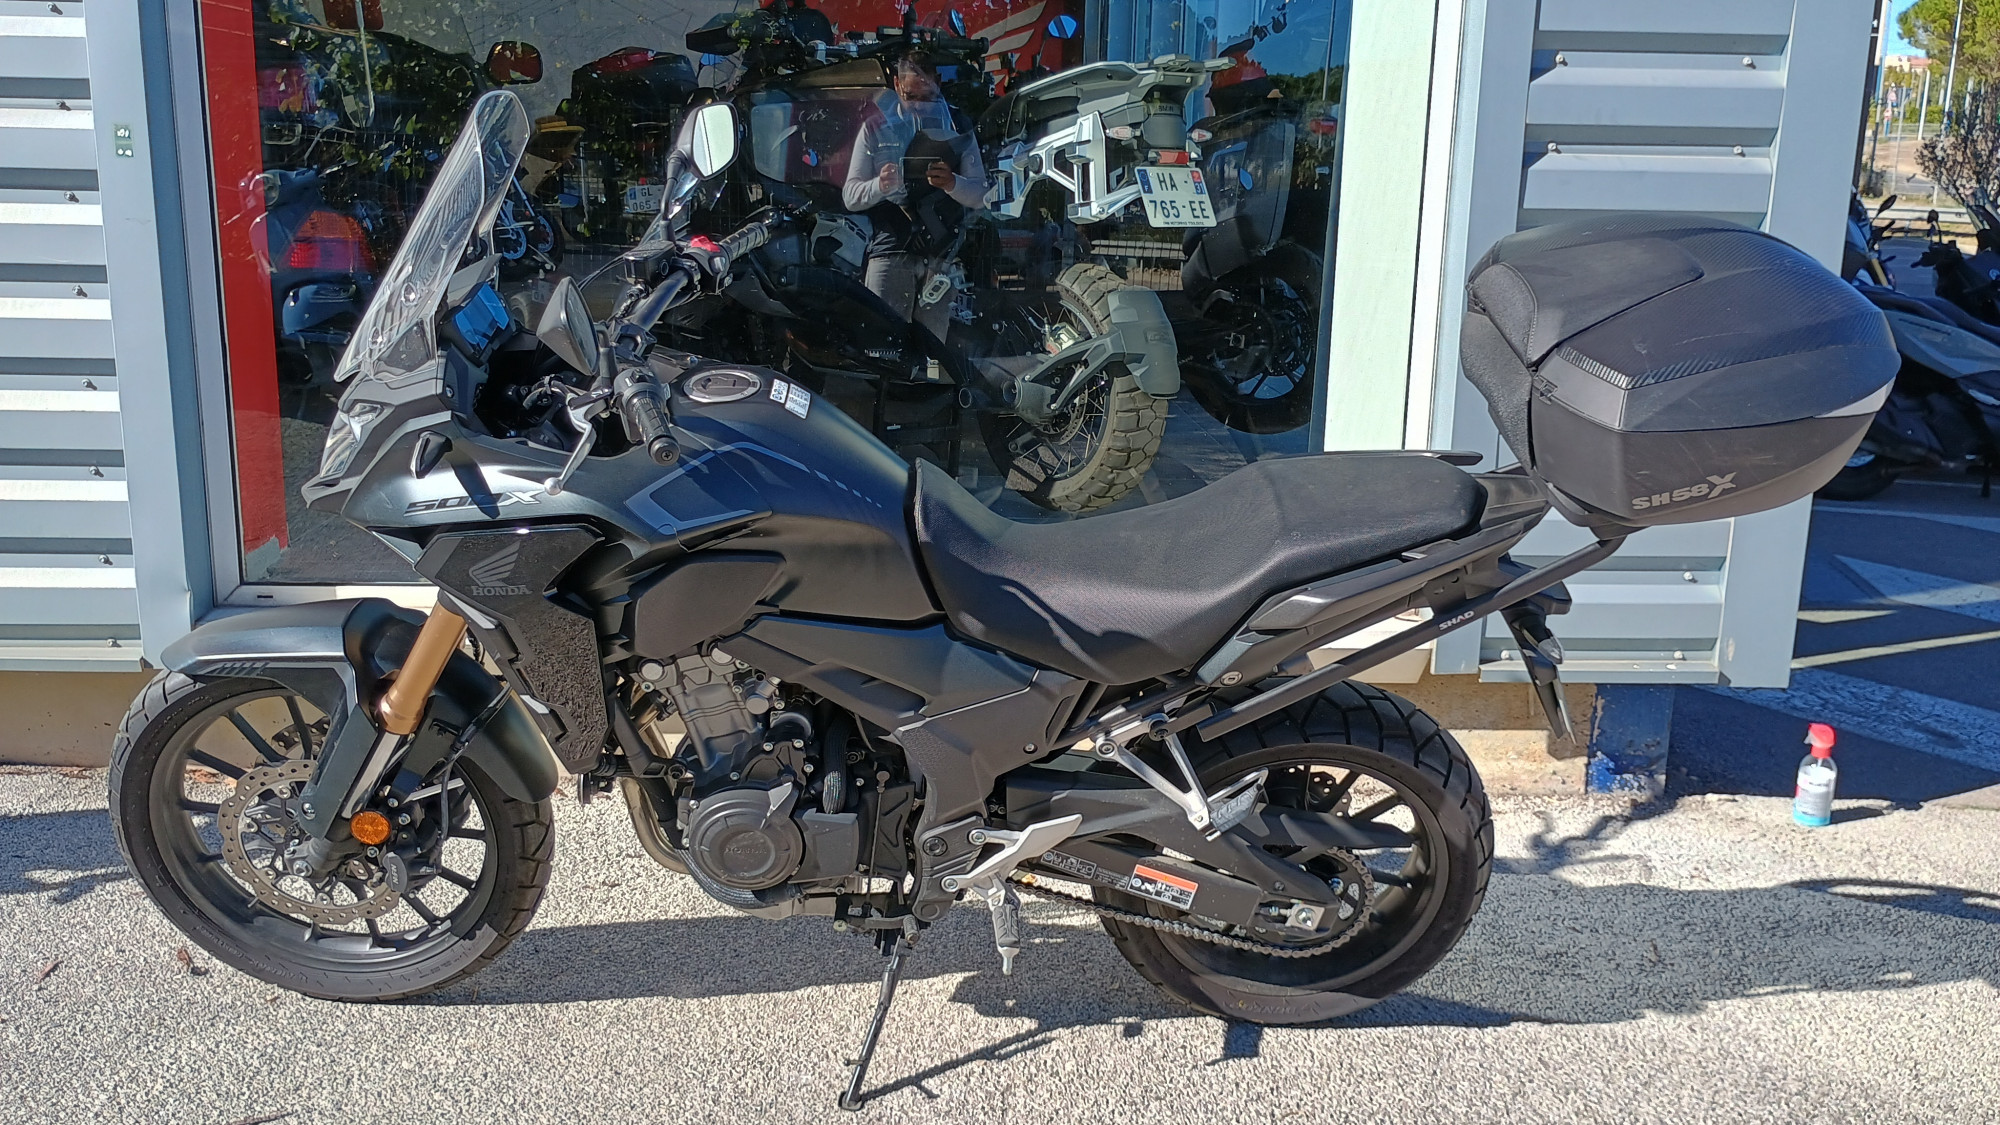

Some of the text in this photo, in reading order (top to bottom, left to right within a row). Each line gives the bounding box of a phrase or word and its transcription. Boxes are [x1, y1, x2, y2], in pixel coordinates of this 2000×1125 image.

[1156, 172, 1178, 191] HA
[1195, 184, 1205, 194] 31
[1631, 471, 1737, 510] SH58X
[471, 585, 533, 596] HONDA
[1438, 610, 1475, 631] SHAD
